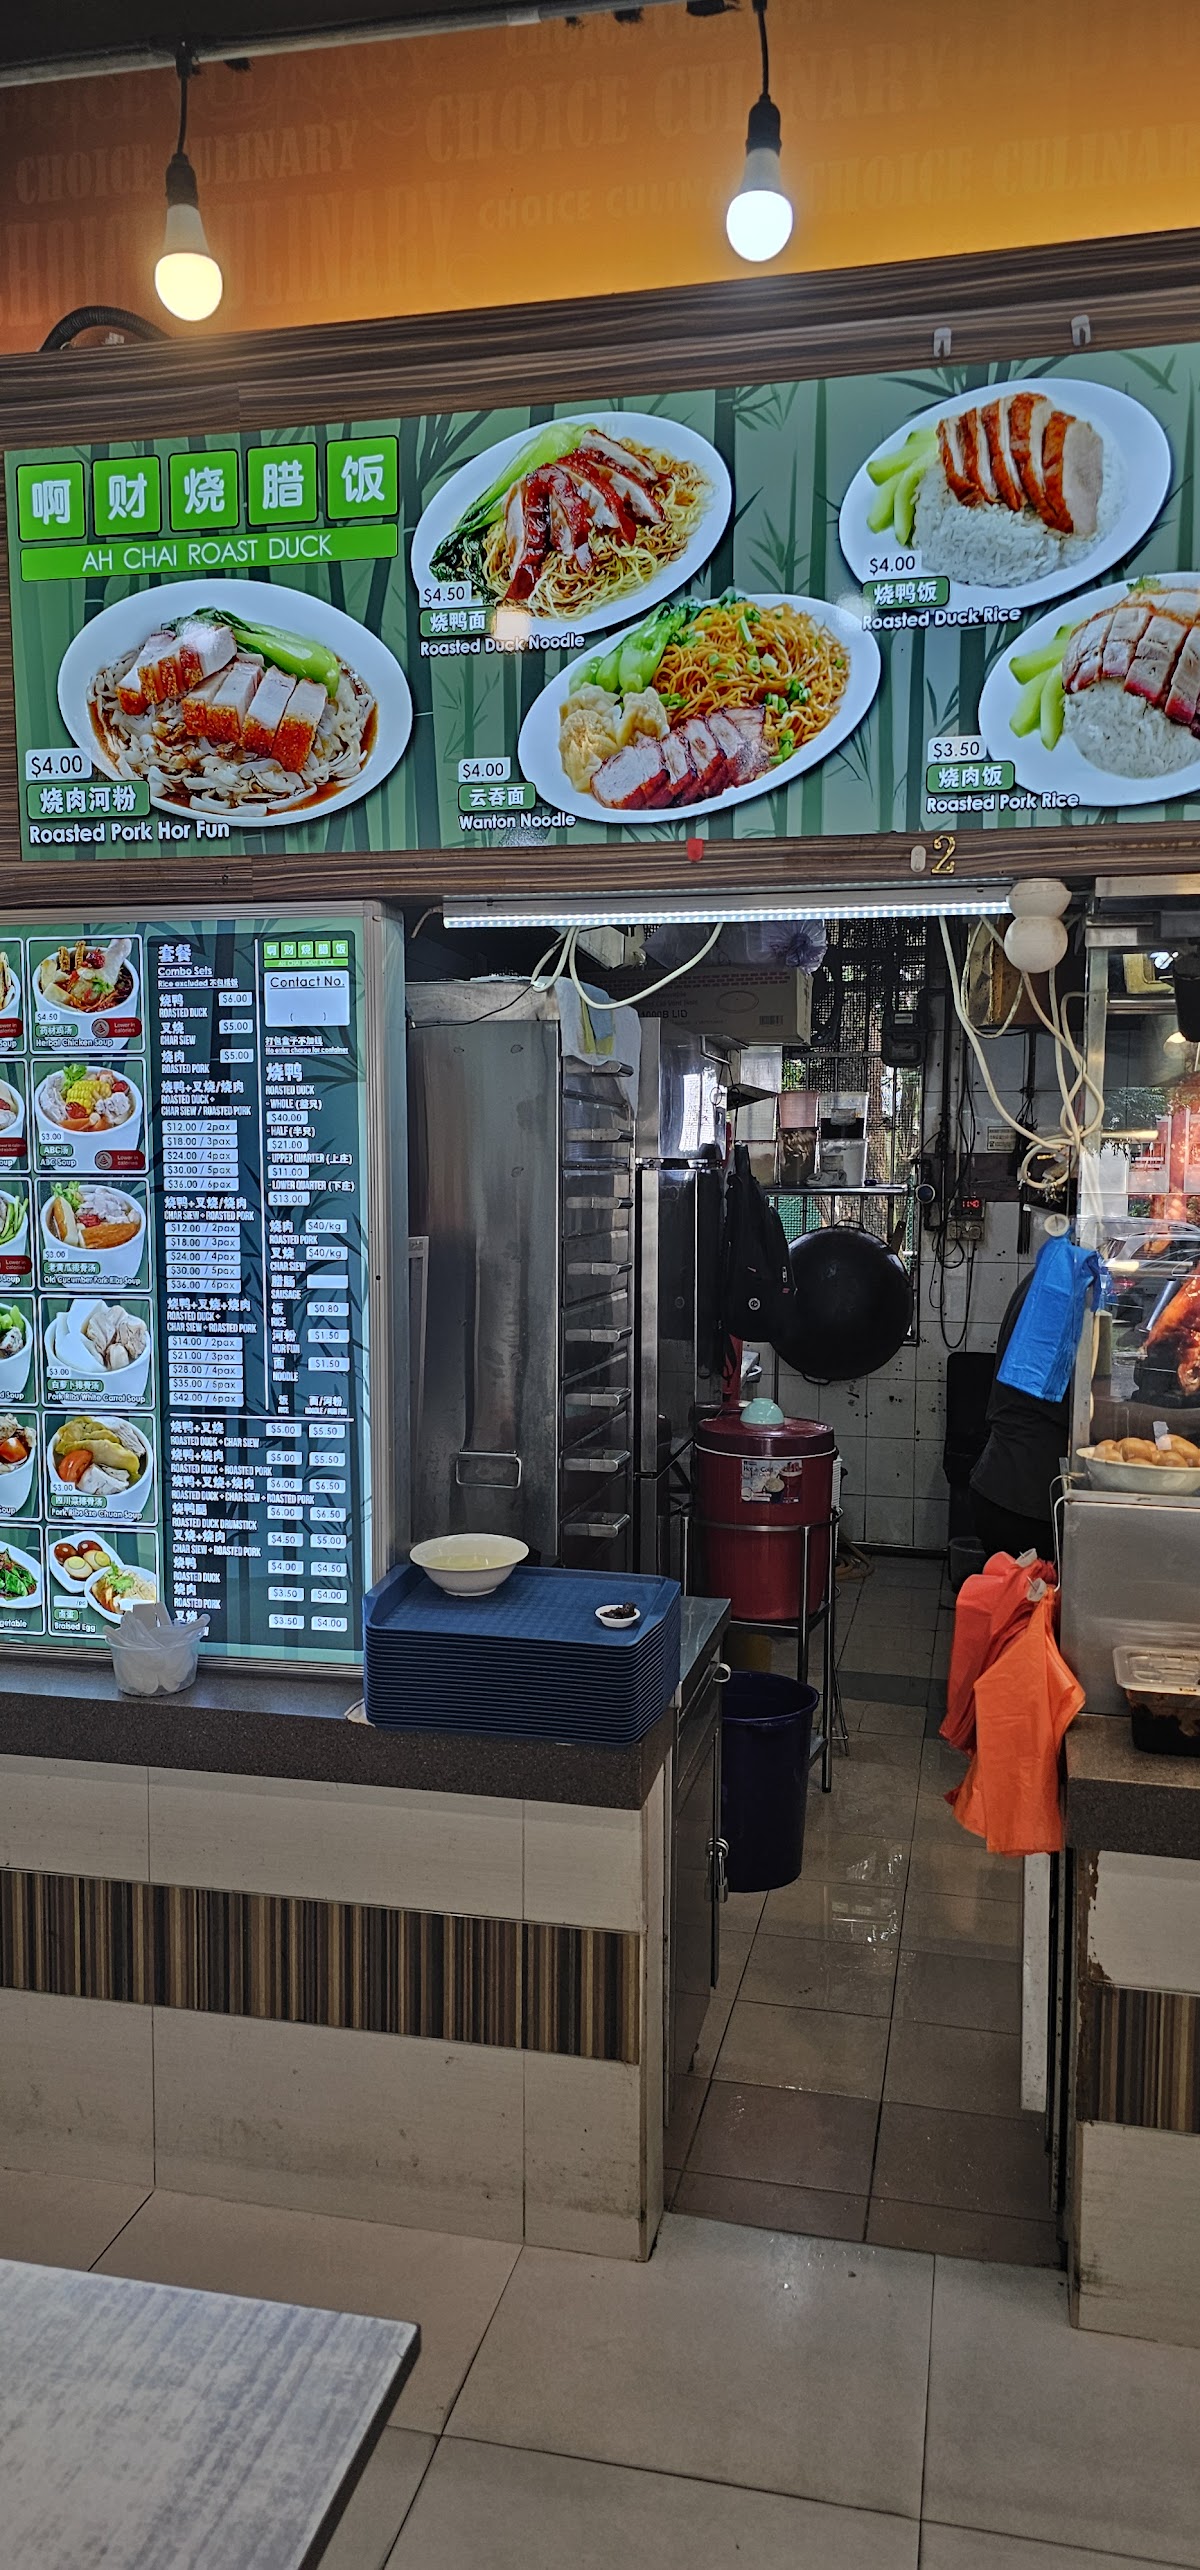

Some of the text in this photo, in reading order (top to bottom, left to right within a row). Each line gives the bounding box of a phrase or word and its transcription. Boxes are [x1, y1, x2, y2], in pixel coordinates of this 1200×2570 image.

[16, 143, 152, 204] CHOICE
[82, 534, 332, 573] AH CHAI ROAST DUCK
[869, 554, 916, 574] $4.00
[422, 585, 466, 604] $4.50
[873, 581, 937, 607] 烧鸭饭
[430, 609, 486, 633] 烧鸭面
[862, 604, 1021, 632] Roasted Duck Rice
[420, 632, 585, 656] Roasted Duck Noodle
[933, 740, 980, 759] $3.50
[29, 755, 83, 778] $4.00
[462, 761, 505, 780] $4.00
[938, 765, 1003, 789] 烧肉饭
[40, 784, 137, 815] 烧肉河粉
[469, 786, 525, 808] 云吞面
[927, 790, 1079, 813] Roasted Pork Rice
[458, 812, 576, 831] Wanton Noodle
[29, 820, 230, 845] Roasted Pork Hor Fun
[931, 836, 957, 874] 2
[158, 944, 192, 962] 套餐
[158, 966, 212, 976] Combo Sets
[270, 975, 345, 988] Contact No.
[222, 993, 248, 1004] $6.00
[37, 1013, 58, 1021] $4.50
[223, 1021, 248, 1032] $5.00
[36, 1039, 113, 1048] Herbal Chicken Soup
[224, 1050, 249, 1061] $5.00
[265, 1062, 303, 1082] 烧鸭
[271, 1113, 302, 1123] $40.00
[167, 1121, 230, 1134] $12.00 2pax
[167, 1136, 231, 1148] $18.00 3pax
[272, 1140, 303, 1149] $21.00
[40, 1158, 76, 1167] ABC Soup
[167, 1151, 231, 1163] $24.00 4pax
[168, 1165, 231, 1176] $30.00 5pax
[272, 1167, 303, 1176] $11.00
[168, 1179, 231, 1191] $36.00 6pax
[273, 1194, 303, 1204] $13.00
[171, 1223, 236, 1234] $12.00 2pax
[308, 1221, 341, 1232] $40/kg
[171, 1237, 236, 1249] $18.00 3pax
[171, 1251, 236, 1263] $24.00 4pax
[308, 1249, 342, 1260] $40/kg
[171, 1266, 235, 1277] $30.00 5pax
[44, 1276, 141, 1286] Old Cucumber Soup
[171, 1280, 235, 1291] $36.00 6pax
[314, 1304, 339, 1313] $0.80
[314, 1331, 340, 1341] $1.50
[172, 1337, 235, 1348] $14.00 2pax
[172, 1351, 235, 1362] $21.00 3pax
[315, 1359, 340, 1369] $1.50
[49, 1368, 69, 1376] $3.00
[173, 1365, 236, 1376] $28.00 4pax
[173, 1379, 236, 1390] $35.00 5pax
[48, 1392, 146, 1404] Pork Ribs White Carrot Soup
[173, 1393, 236, 1404] $42.00 6pax
[271, 1425, 338, 1436] $5.00 $5.50
[270, 1453, 339, 1465] $5.00 $5.50
[53, 1484, 73, 1492] $3.00
[270, 1479, 340, 1491] $6.00 $6.50
[51, 1508, 67, 1517] Pork
[98, 1510, 123, 1518] Chuan
[124, 1512, 143, 1520] Soup
[270, 1507, 341, 1519] $6.00 $6.50
[271, 1535, 342, 1545] $4.50 $5.00
[271, 1562, 342, 1573] $4.00 $4.50
[273, 1588, 342, 1600] $3.50 $4.00
[54, 1622, 96, 1633] Braised Egg
[273, 1616, 342, 1628] $3.50 $4.00
